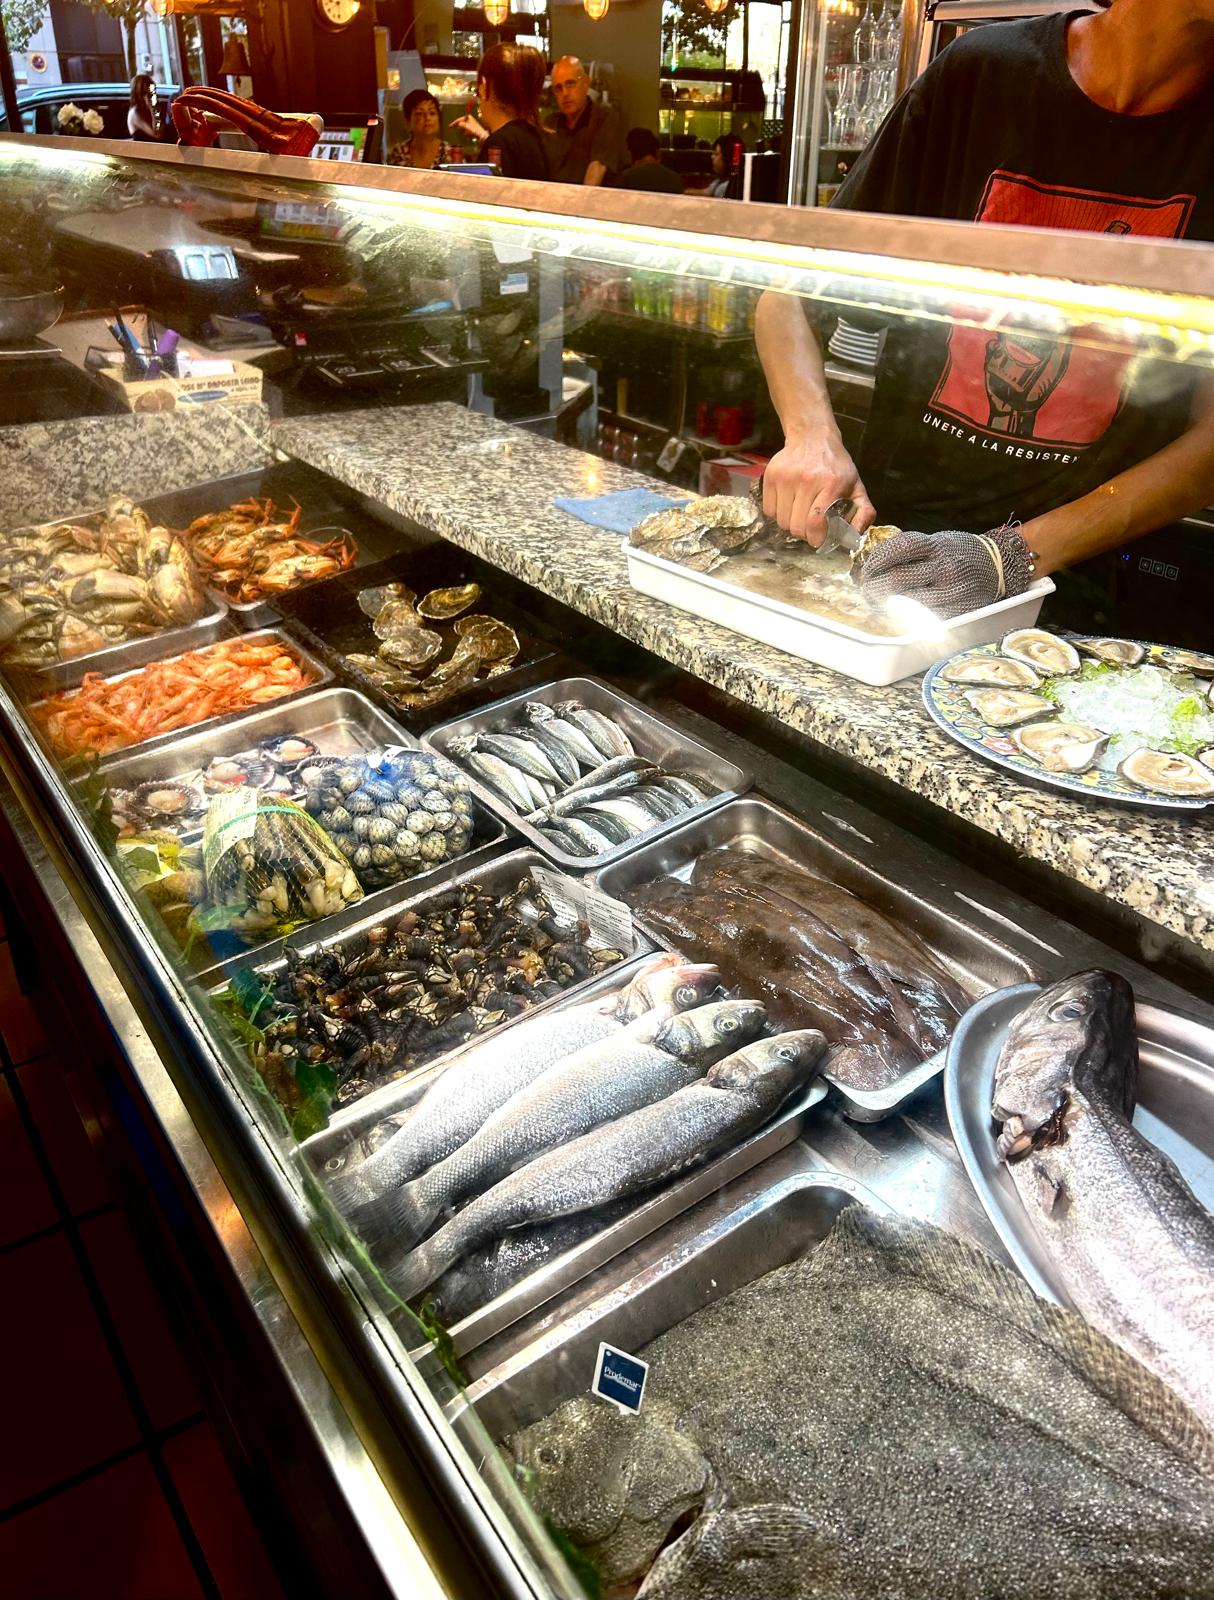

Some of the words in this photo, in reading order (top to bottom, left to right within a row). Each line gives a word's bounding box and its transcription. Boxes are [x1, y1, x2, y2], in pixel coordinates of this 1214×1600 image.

[922, 413, 965, 438] ÚNETE
[967, 434, 978, 444] A
[981, 439, 999, 452] LA
[604, 1365, 640, 1389] Prodemar
